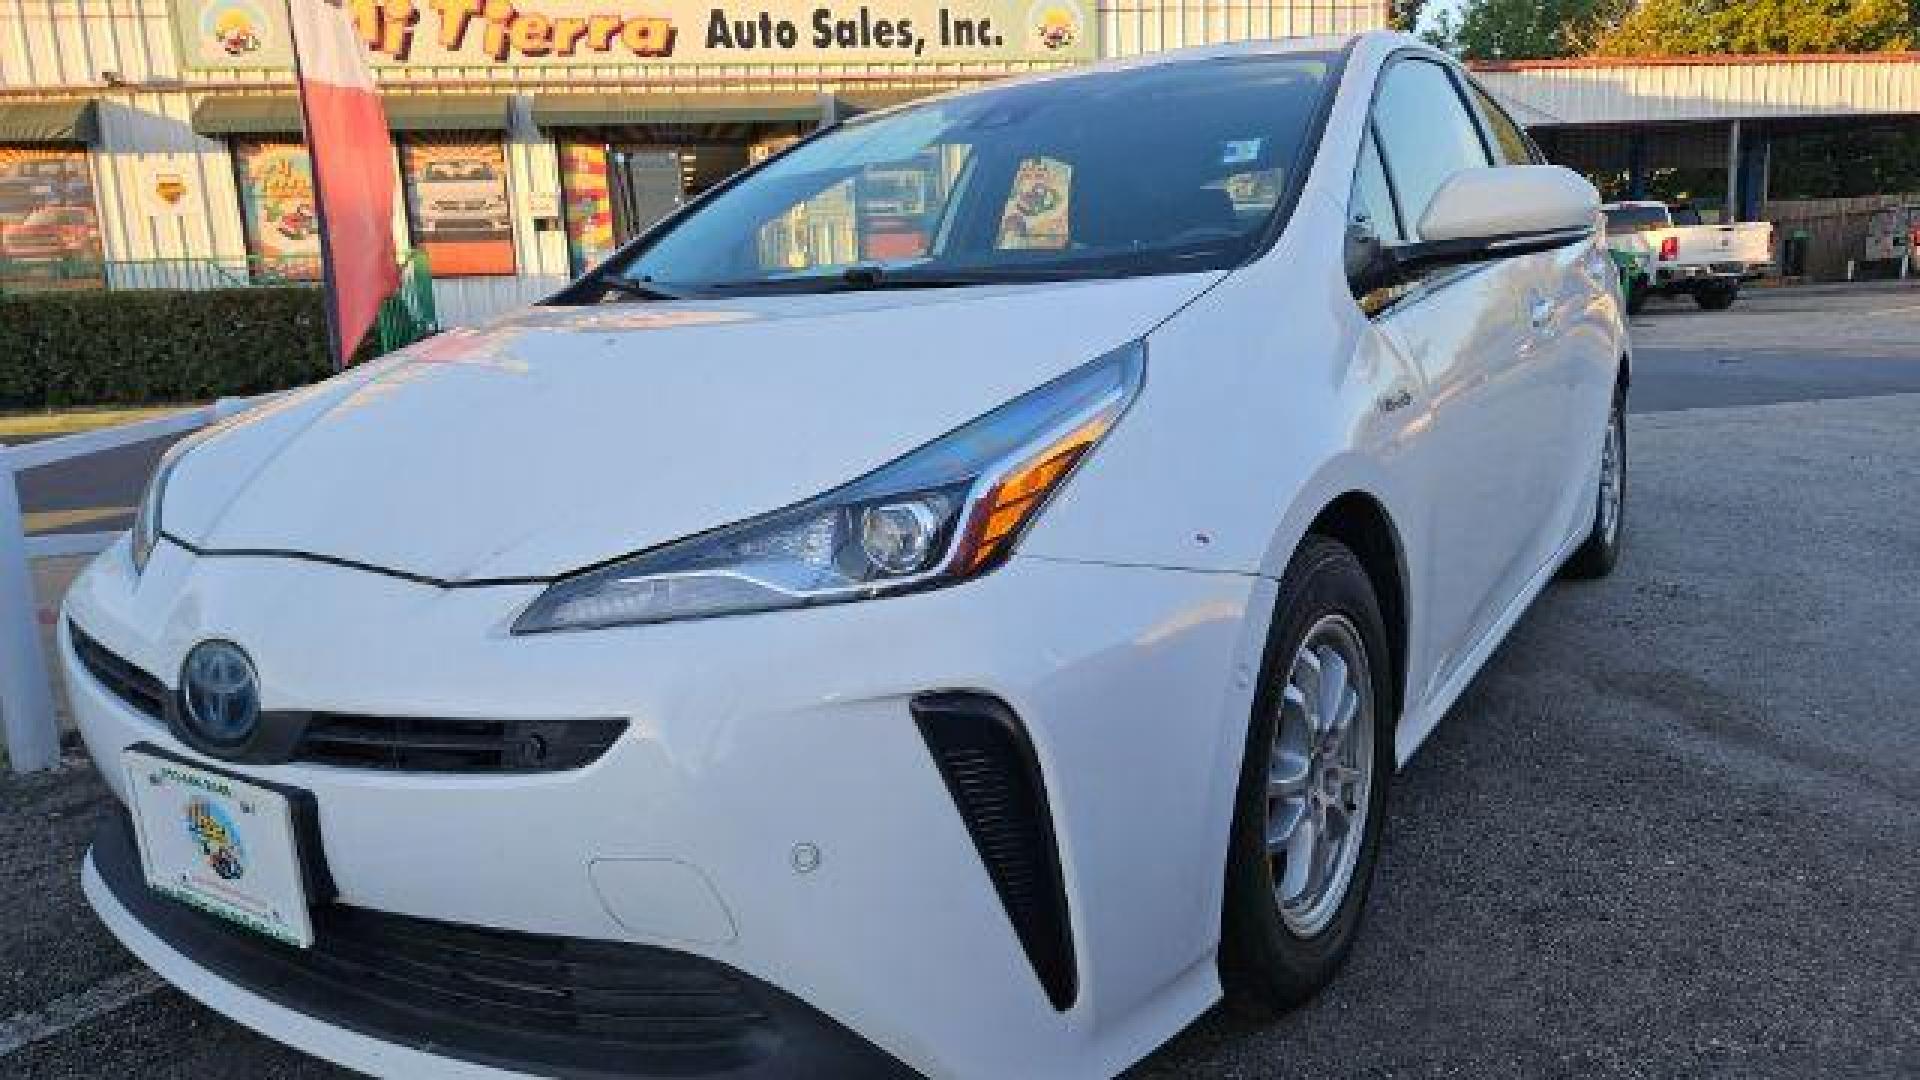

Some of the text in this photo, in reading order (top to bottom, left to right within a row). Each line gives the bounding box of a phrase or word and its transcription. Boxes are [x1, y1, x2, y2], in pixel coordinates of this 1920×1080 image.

[428, 0, 677, 62] Tierra
[704, 9, 798, 49] Auto
[811, 6, 925, 56] Sales,
[938, 9, 1003, 46] Inc.
